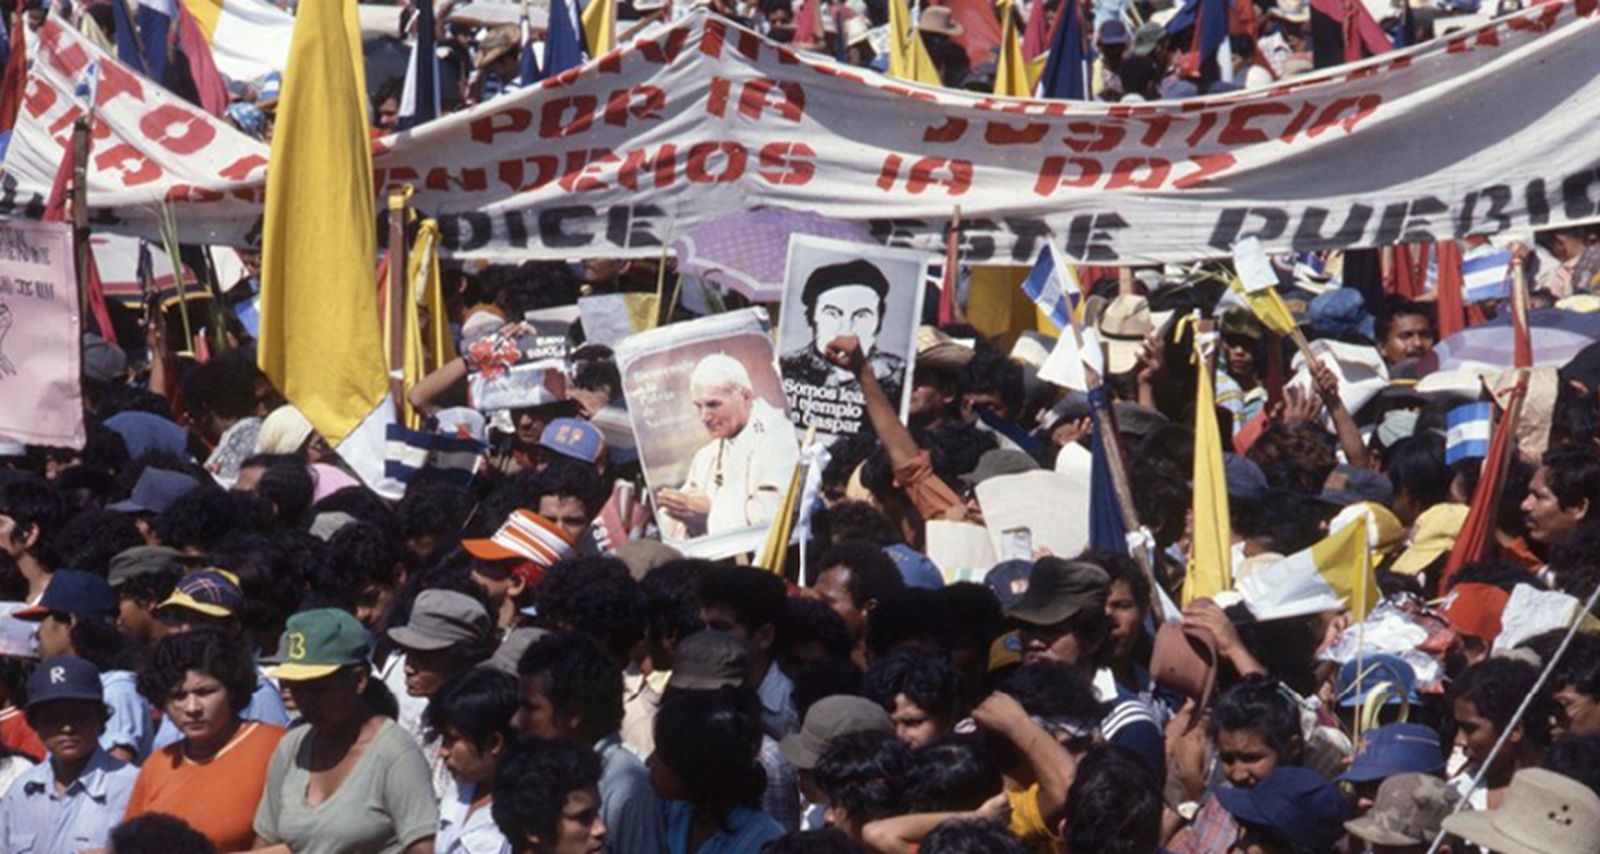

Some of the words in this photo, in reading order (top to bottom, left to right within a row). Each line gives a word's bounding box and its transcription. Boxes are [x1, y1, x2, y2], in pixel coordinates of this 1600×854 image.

[469, 84, 666, 145] POR
[922, 93, 1383, 154] JUSTICIA
[1033, 153, 1238, 197] PAZ
[437, 203, 668, 252] DICE
[868, 212, 1132, 261] ESTE
[784, 378, 837, 401] Somos
[839, 387, 866, 405] lea
[799, 398, 863, 420] ejemplo
[802, 411, 862, 434] Gaspar
[50, 666, 66, 684] R
